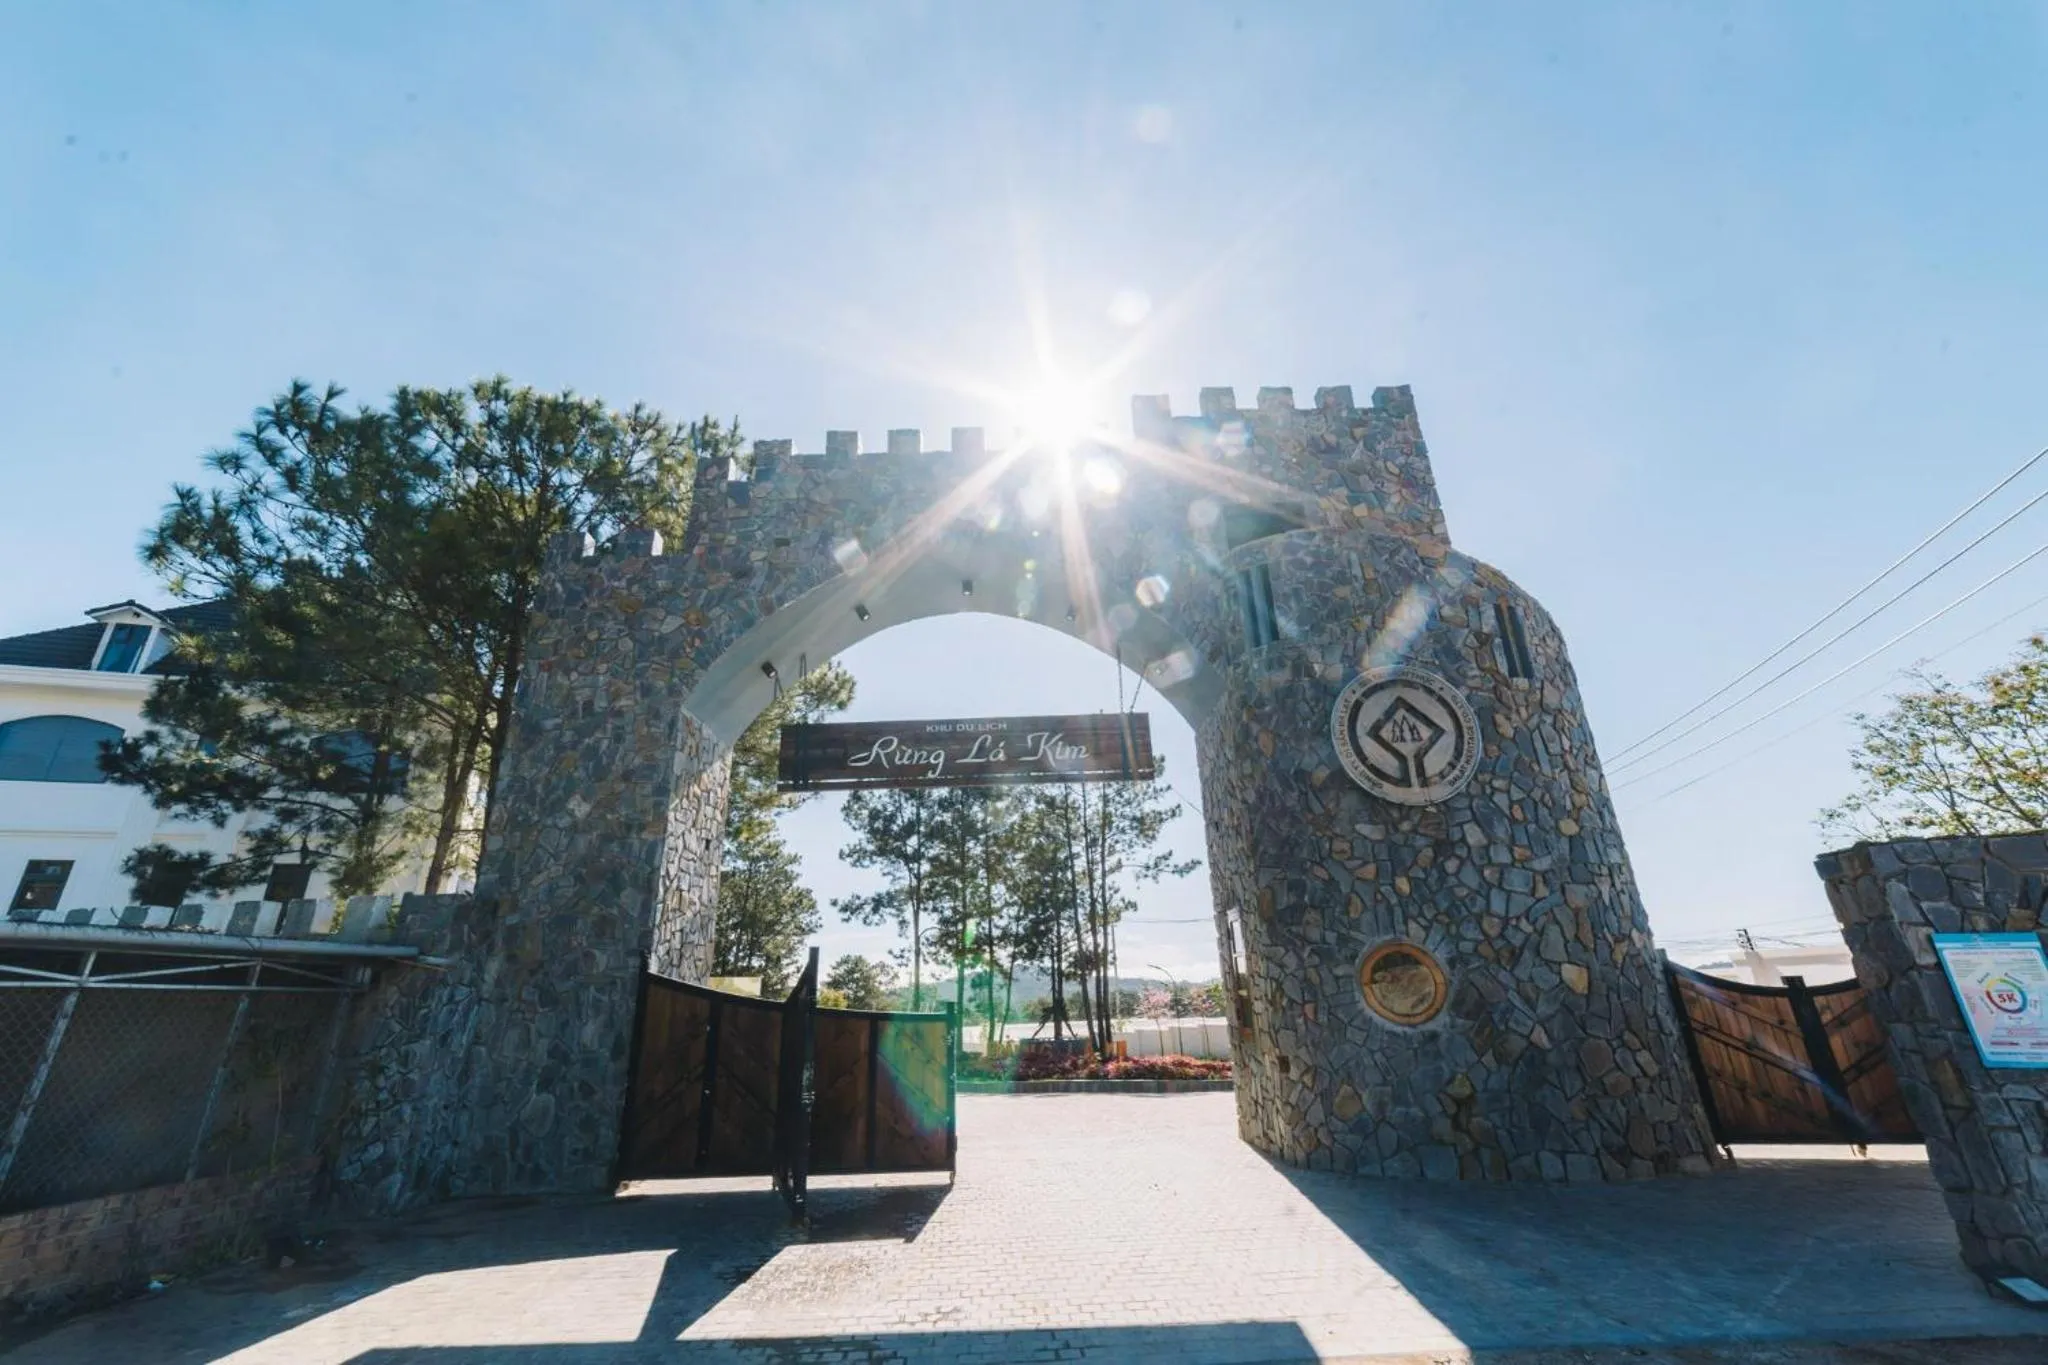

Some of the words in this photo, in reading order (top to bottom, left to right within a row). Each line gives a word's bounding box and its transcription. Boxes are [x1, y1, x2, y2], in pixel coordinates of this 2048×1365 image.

[926, 723, 952, 733] KHU
[956, 723, 974, 732] DU
[955, 734, 1007, 763] Lá
[1016, 731, 1090, 768] Kim
[1998, 993, 2018, 1003] 5K
